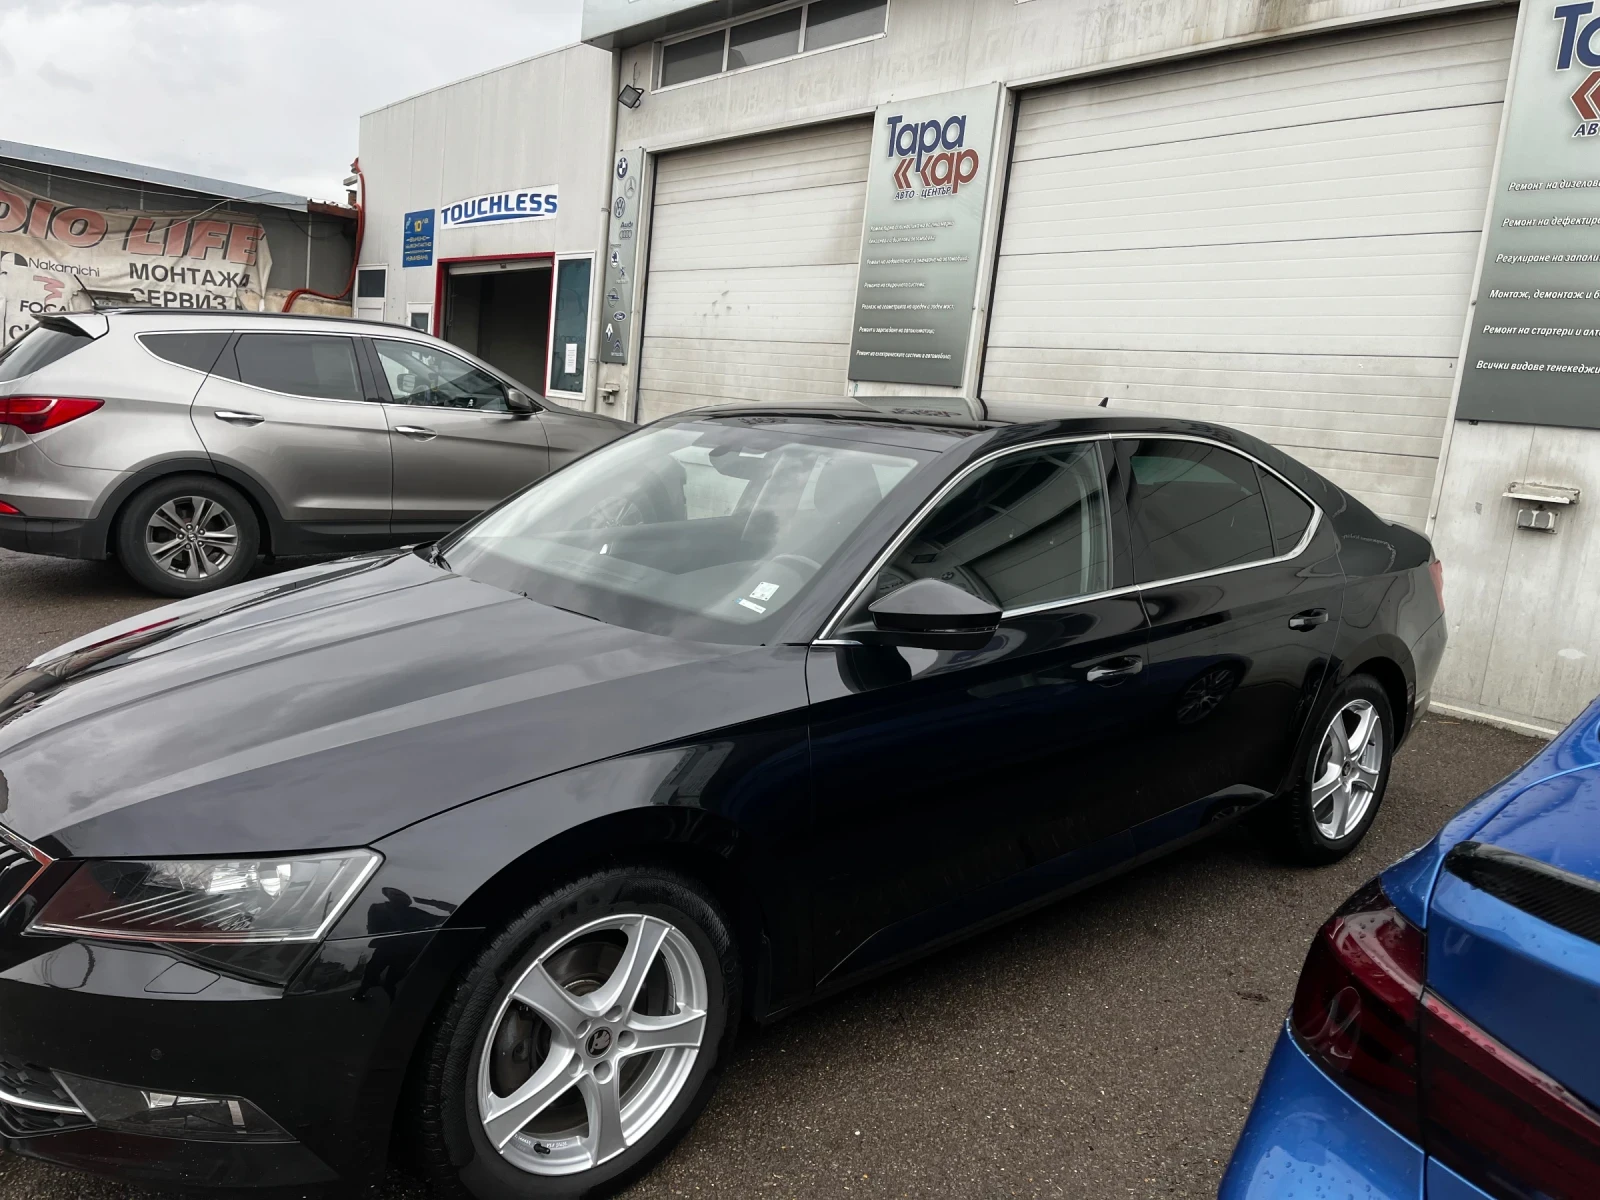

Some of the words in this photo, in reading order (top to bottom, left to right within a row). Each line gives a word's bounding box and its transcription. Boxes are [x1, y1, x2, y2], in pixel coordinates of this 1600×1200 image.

[1573, 122, 1600, 137] АВ
[887, 115, 967, 172] Тара
[1508, 181, 1543, 191] Ремонт
[1559, 178, 1600, 188] дизелов
[895, 190, 915, 200] АВТО
[921, 187, 951, 198] ЦЕНТЪР
[441, 193, 557, 225] TOUCHLESS
[1501, 218, 1537, 227] Ремонт
[123, 217, 266, 266] LIFE
[1495, 254, 1550, 264] Регулиране
[1564, 254, 1600, 262] запали
[28, 257, 100, 277] Nakamichi
[1489, 290, 1531, 300] Монтаж,
[1533, 289, 1584, 299] демонтаж
[1482, 325, 1517, 334] Ремонт
[1531, 327, 1574, 337] стартери
[1476, 360, 1510, 370] Всички
[1511, 361, 1544, 371] видове
